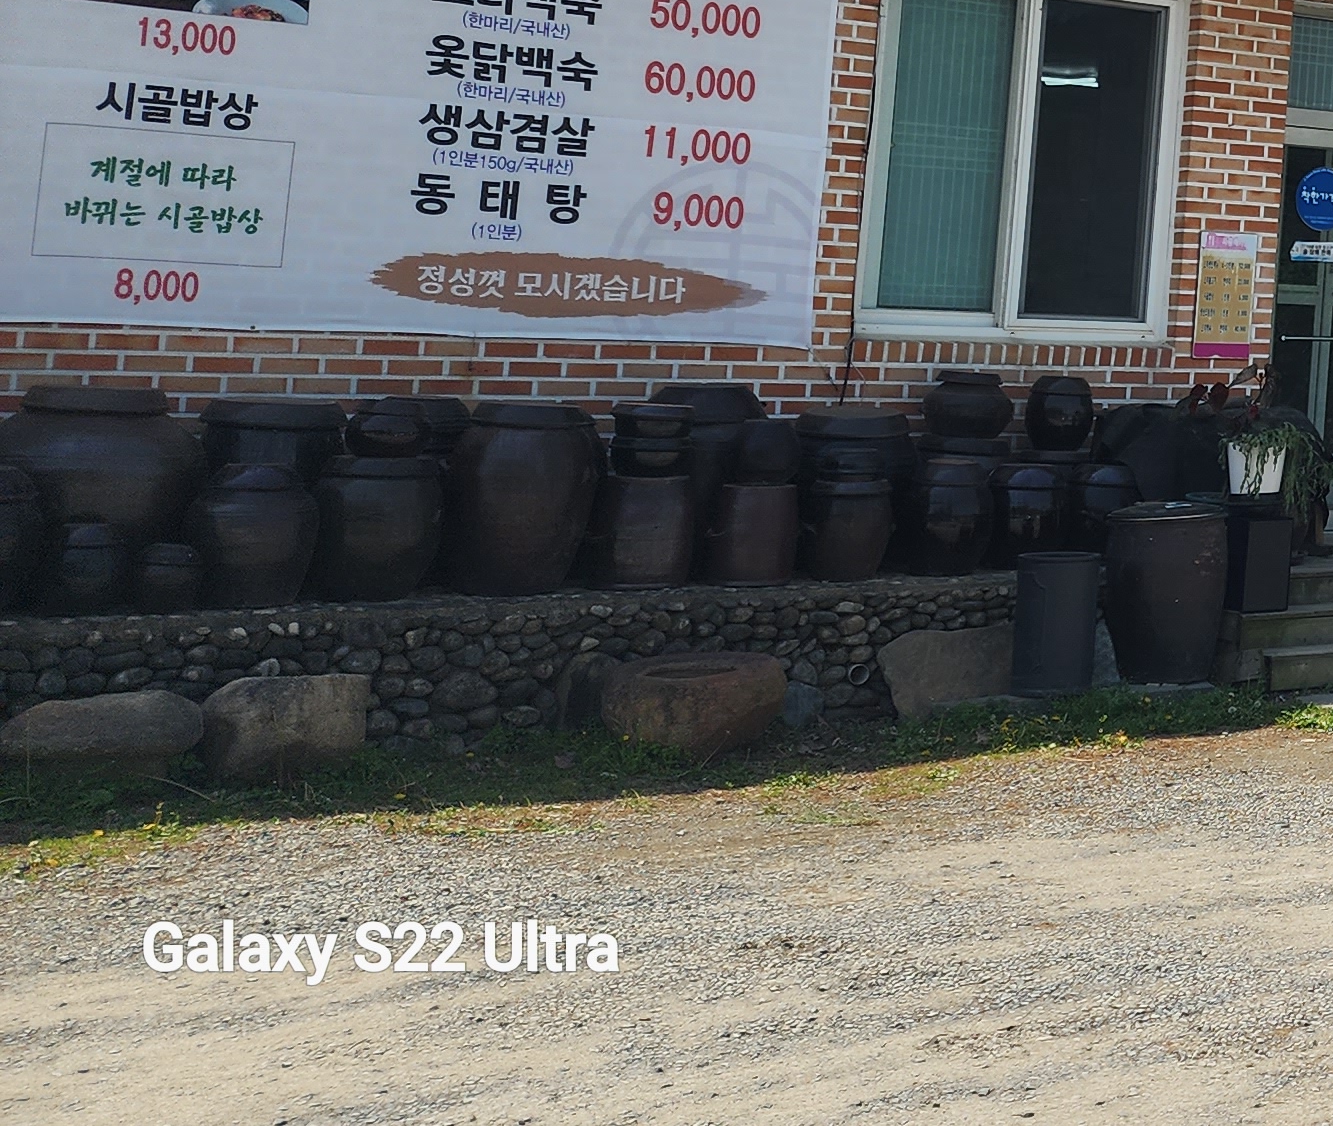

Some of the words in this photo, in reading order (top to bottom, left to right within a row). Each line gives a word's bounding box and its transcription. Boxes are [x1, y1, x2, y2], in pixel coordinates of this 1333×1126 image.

[137, 16, 236, 56] 13,000
[462, 12, 570, 40] (한마리/국내산)
[425, 35, 598, 92] 옻닭백숙
[644, 61, 756, 102] 60,000
[96, 81, 258, 130] 시골밥상
[457, 81, 566, 108] (한마리/국내산)
[432, 149, 574, 176] (1인분150g/국내산)
[644, 126, 751, 165] 11,000
[90, 158, 171, 186] 계절에
[181, 164, 236, 191] 따라
[65, 196, 146, 227] 바뀌는
[157, 202, 263, 235] 시골밥상
[652, 191, 745, 231] 9,000
[471, 222, 523, 242] (1인분)
[114, 269, 199, 303] 8,000
[418, 264, 505, 298] 정성껏
[514, 267, 686, 305] 모시겠습니다
